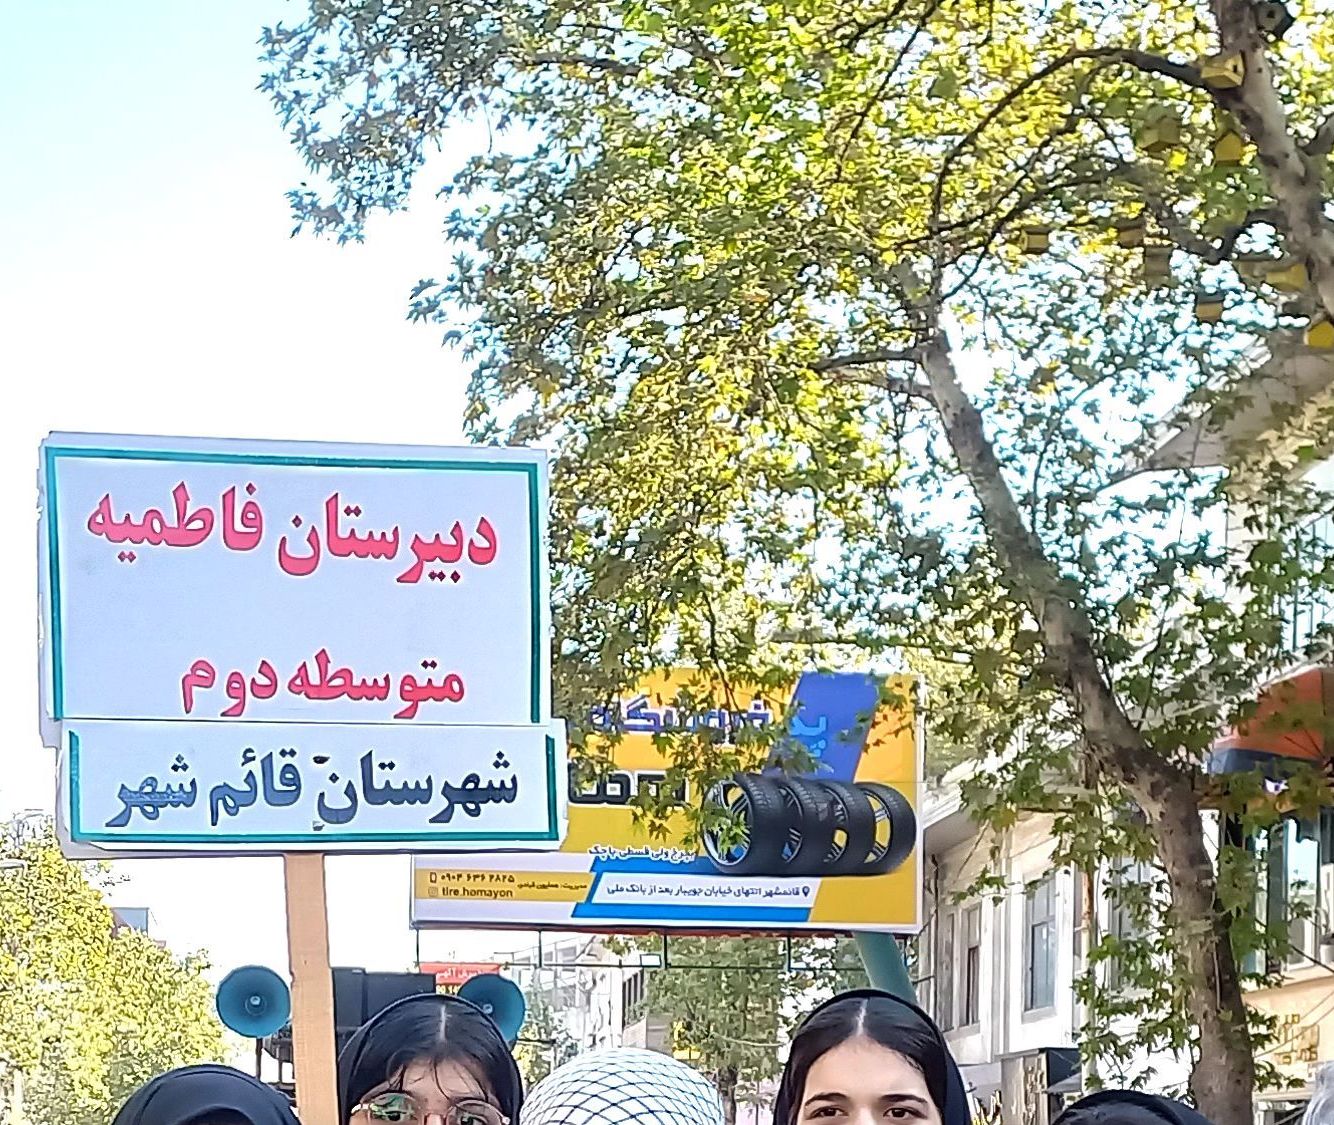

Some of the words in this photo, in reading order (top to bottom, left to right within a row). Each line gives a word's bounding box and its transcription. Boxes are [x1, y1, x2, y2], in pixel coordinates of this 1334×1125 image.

[88, 482, 264, 562] فاطمیه
[279, 493, 497, 583] دبیرستان
[182, 659, 278, 716] دوم
[288, 648, 464, 719] متوسطه
[105, 753, 197, 827] شهر
[210, 748, 302, 826] قائم
[314, 750, 517, 826] شهرستان
